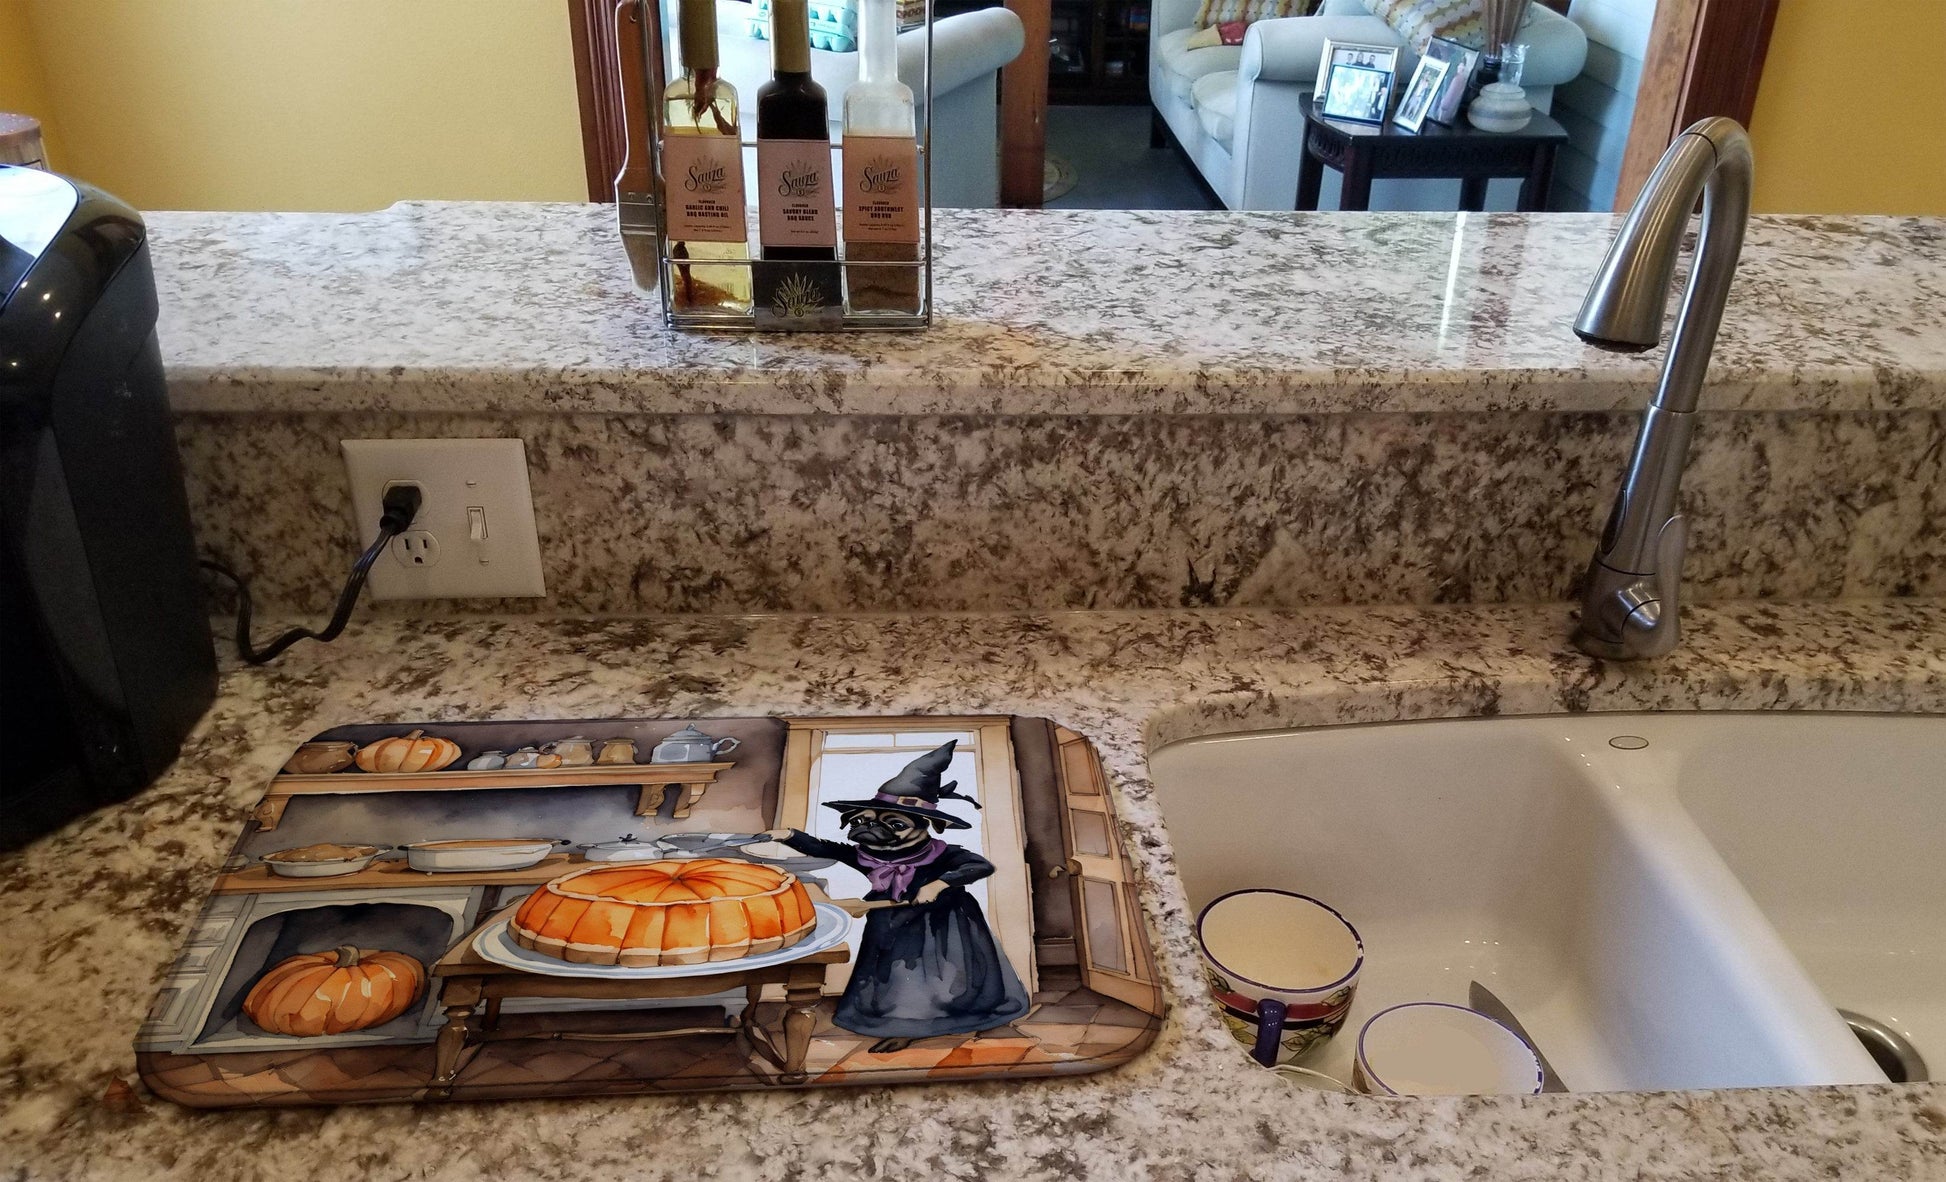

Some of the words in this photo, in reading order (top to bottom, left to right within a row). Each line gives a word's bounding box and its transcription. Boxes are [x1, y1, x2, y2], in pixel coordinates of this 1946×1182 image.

[684, 165, 726, 192] Sauza
[778, 170, 819, 197] Sauza
[859, 166, 900, 193] Sauza
